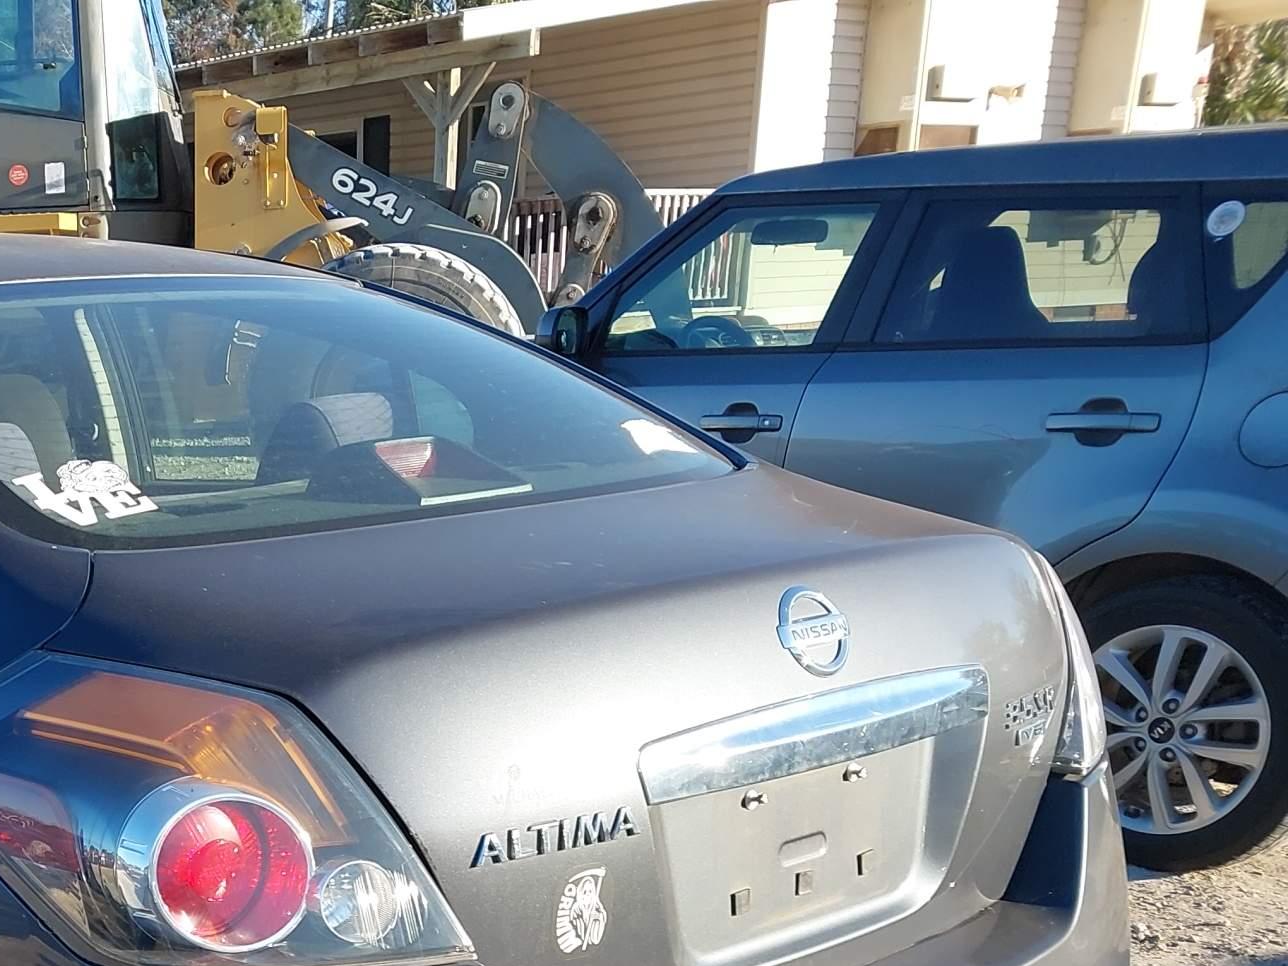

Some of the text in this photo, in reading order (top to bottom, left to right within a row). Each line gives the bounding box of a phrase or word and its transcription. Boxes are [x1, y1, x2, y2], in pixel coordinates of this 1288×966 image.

[332, 168, 413, 225] 624J
[792, 619, 849, 640] NISSAN
[469, 805, 640, 869] ALTIMA
